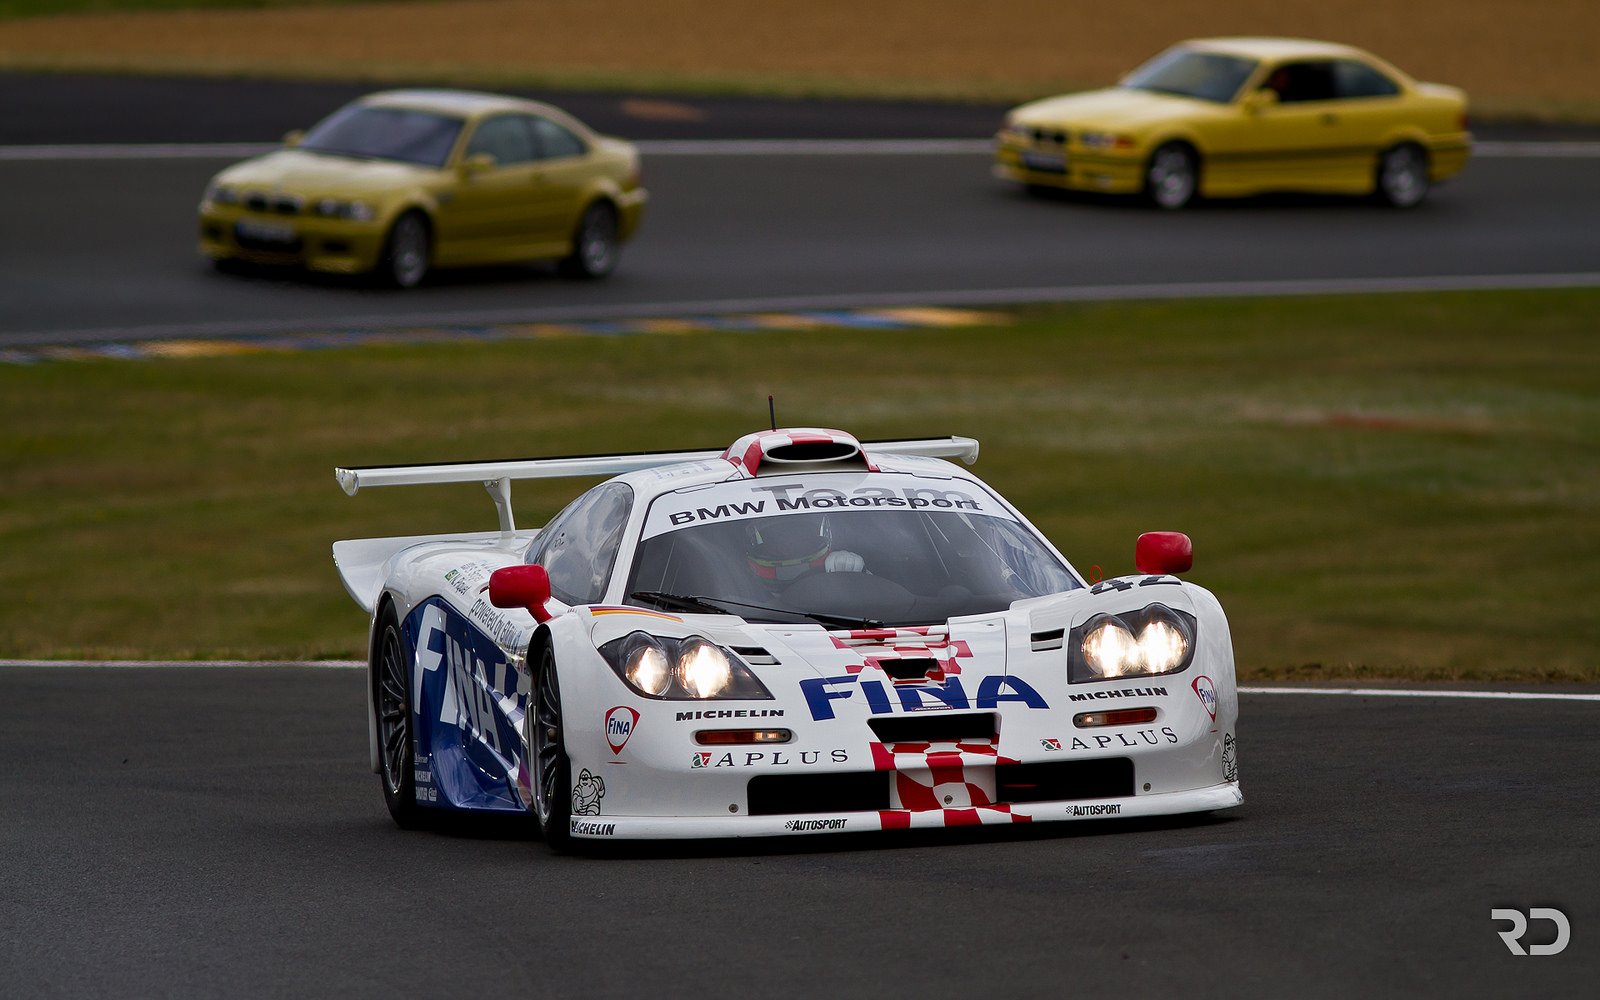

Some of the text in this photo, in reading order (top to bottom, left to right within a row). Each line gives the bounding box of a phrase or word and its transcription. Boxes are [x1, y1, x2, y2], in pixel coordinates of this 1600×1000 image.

[751, 484, 975, 510] Team
[669, 496, 984, 526] BMW Motorsport
[468, 598, 502, 632] powered
[493, 613, 506, 642] by
[799, 675, 1051, 721] FINA
[1068, 687, 1169, 702] MICHELIN
[1199, 688, 1217, 703] FINA
[676, 710, 784, 721] MICHELIN
[608, 718, 630, 735] FINA
[1071, 727, 1178, 750] APLUS
[715, 749, 848, 767] APLUS
[1073, 804, 1121, 816] AUTOSPORT
[571, 820, 615, 836] MICHELIN
[791, 819, 848, 831] AUTOSPORT
